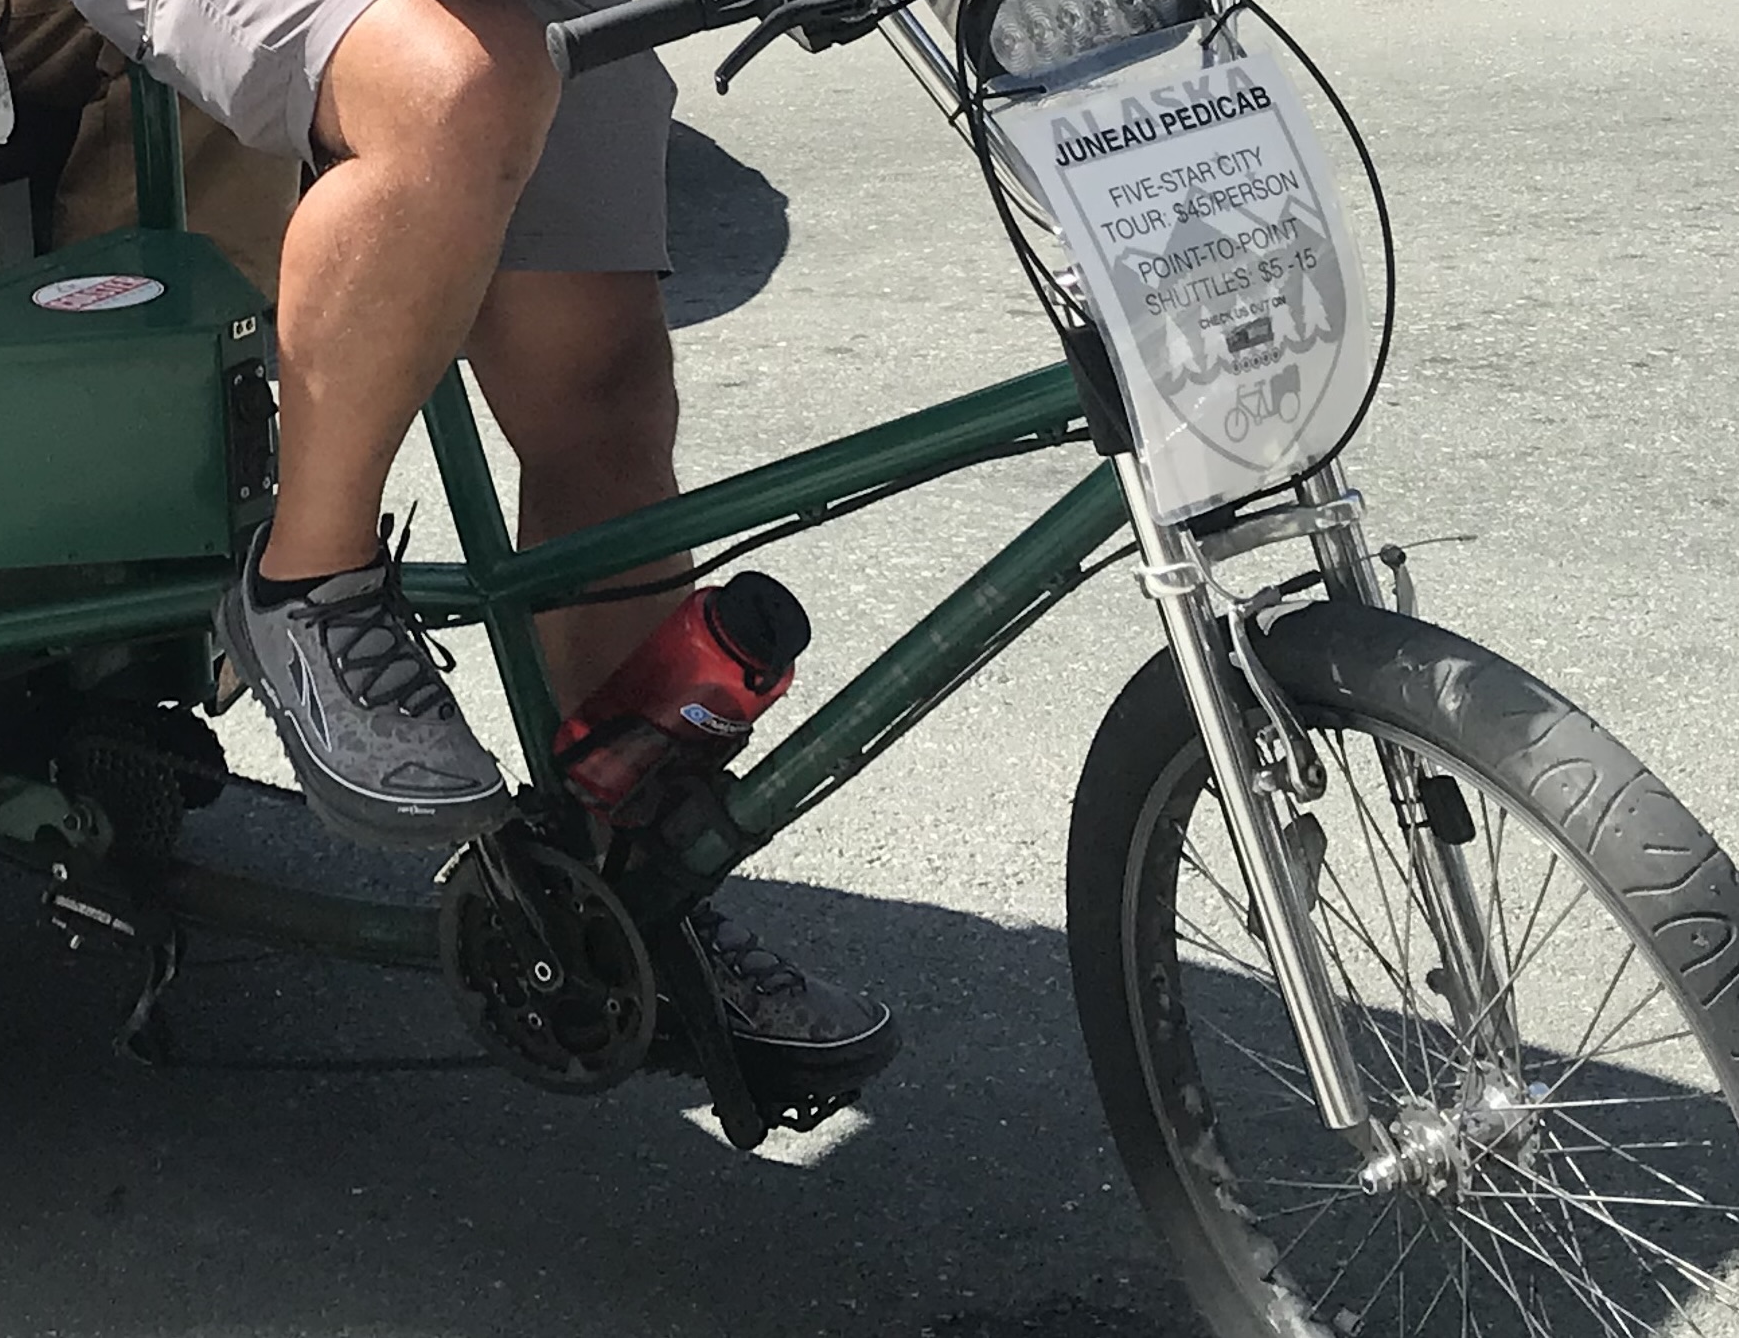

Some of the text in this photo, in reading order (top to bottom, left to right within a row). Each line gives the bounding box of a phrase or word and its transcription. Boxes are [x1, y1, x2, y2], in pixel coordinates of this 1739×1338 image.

[1056, 86, 1272, 166] JUNEAU PEDICAB
[1100, 170, 1300, 243] TOUR: $45/PERSON
[1108, 146, 1263, 208] FIVE-STAR CITY
[1138, 218, 1298, 284] POINT-TO-POINT
[1145, 268, 1257, 316] SHUTTLES:
